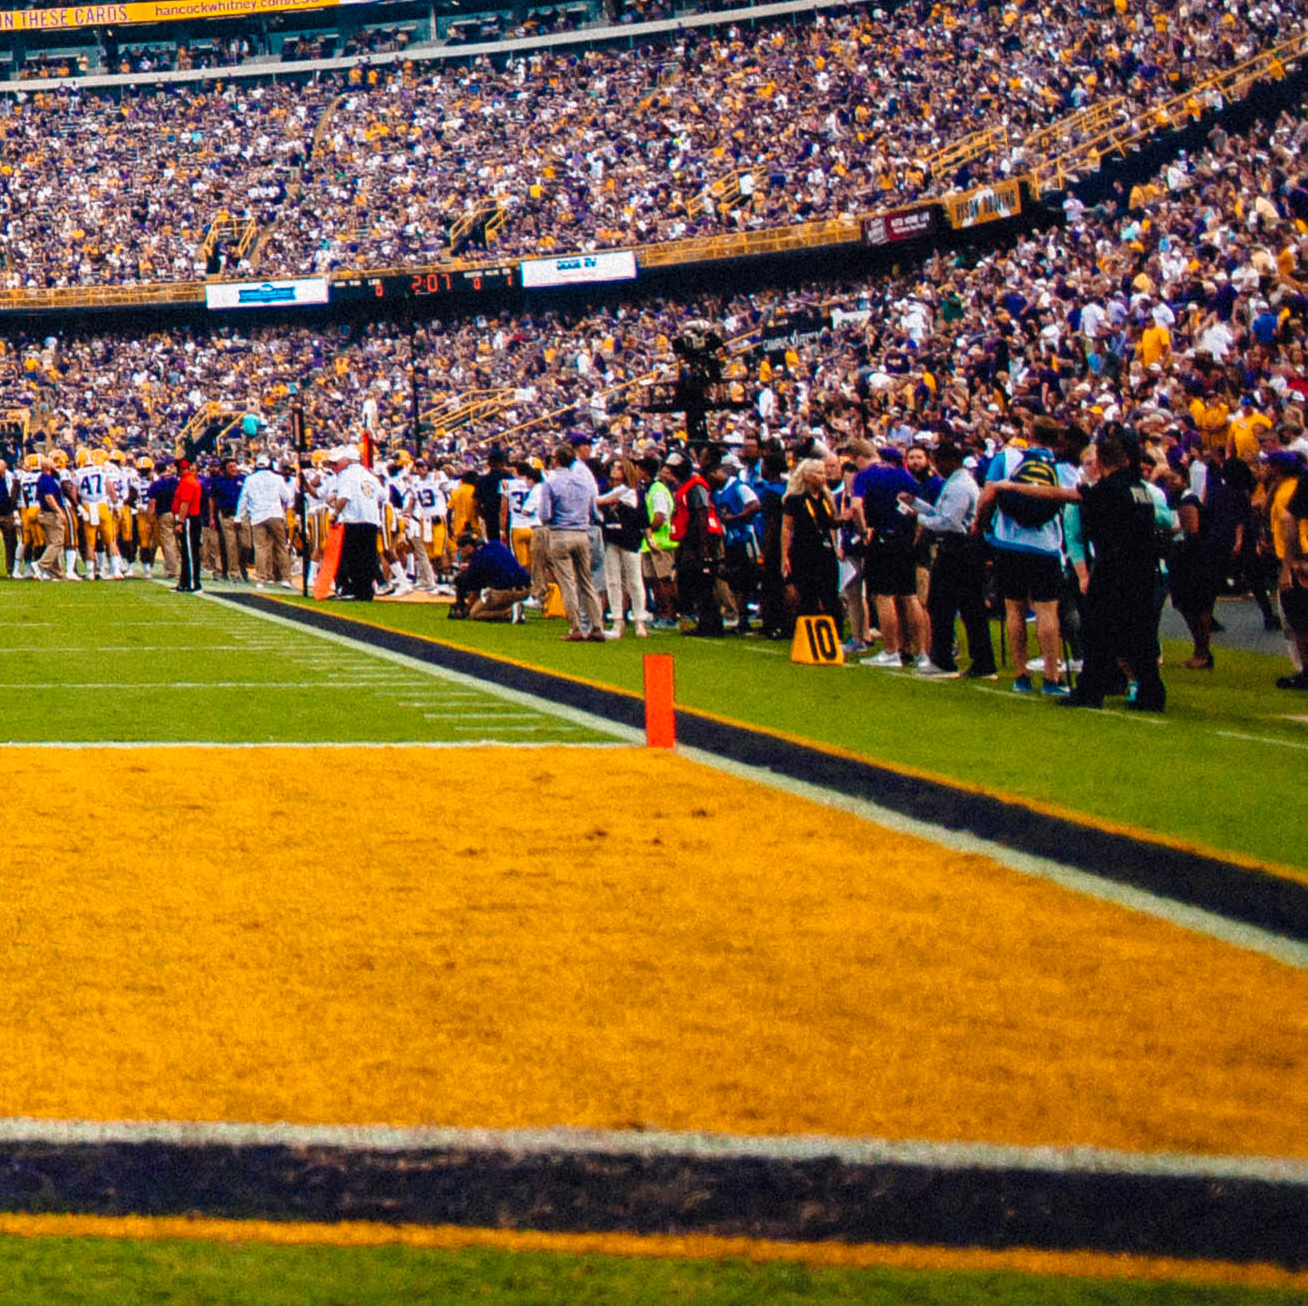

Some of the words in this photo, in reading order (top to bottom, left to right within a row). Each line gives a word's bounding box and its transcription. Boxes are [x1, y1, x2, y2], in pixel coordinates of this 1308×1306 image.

[19, 8, 68, 27] THESE
[74, 5, 132, 25] CARDS.
[411, 273, 451, 294] 2:07
[80, 474, 102, 495] 47
[417, 489, 436, 508] 13
[804, 618, 837, 661] 10
